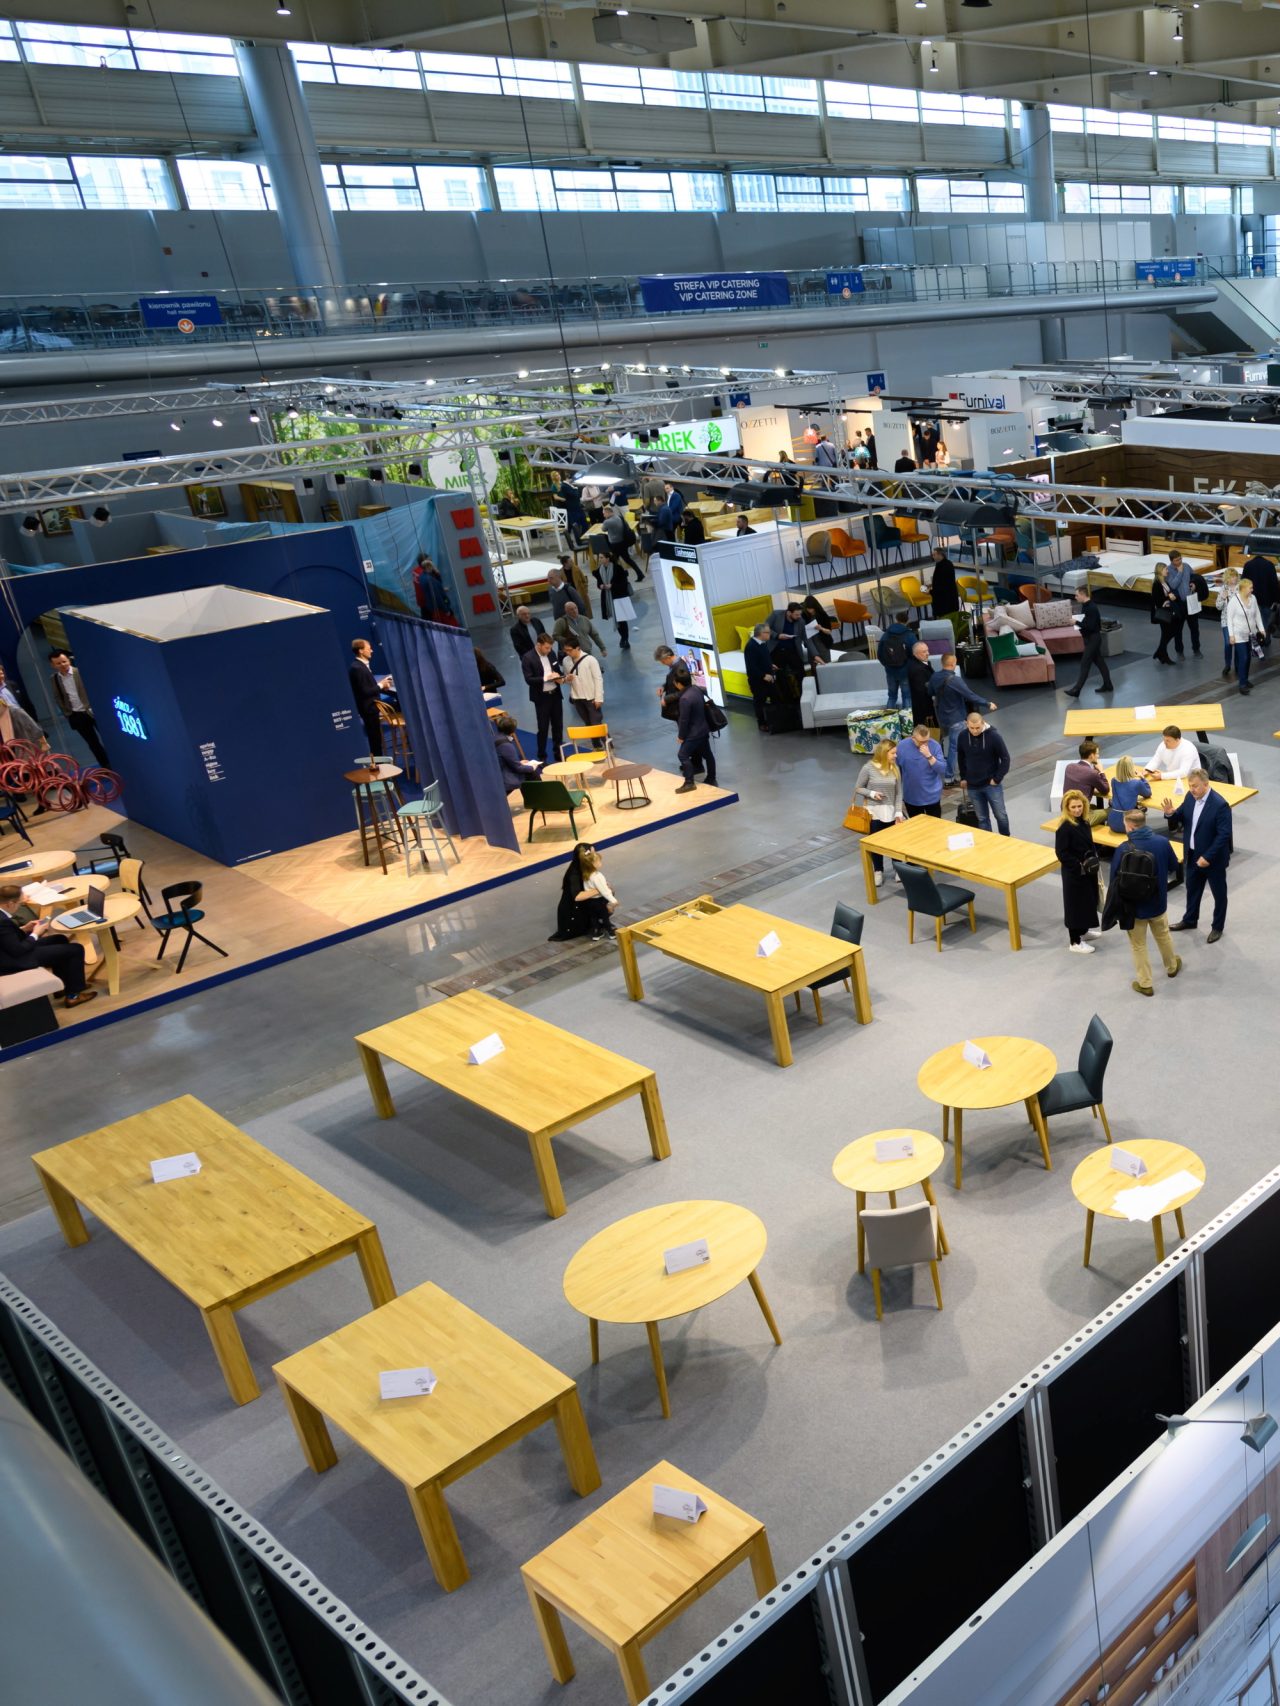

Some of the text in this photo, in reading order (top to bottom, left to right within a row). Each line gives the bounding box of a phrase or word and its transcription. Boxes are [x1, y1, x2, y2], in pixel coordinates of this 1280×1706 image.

[673, 278, 760, 291] STREFA VIP CATERING
[679, 289, 758, 302] VIP CATERING ZONE
[741, 417, 778, 429] OZZETTI
[113, 695, 135, 714] since
[117, 710, 148, 740] 1881
